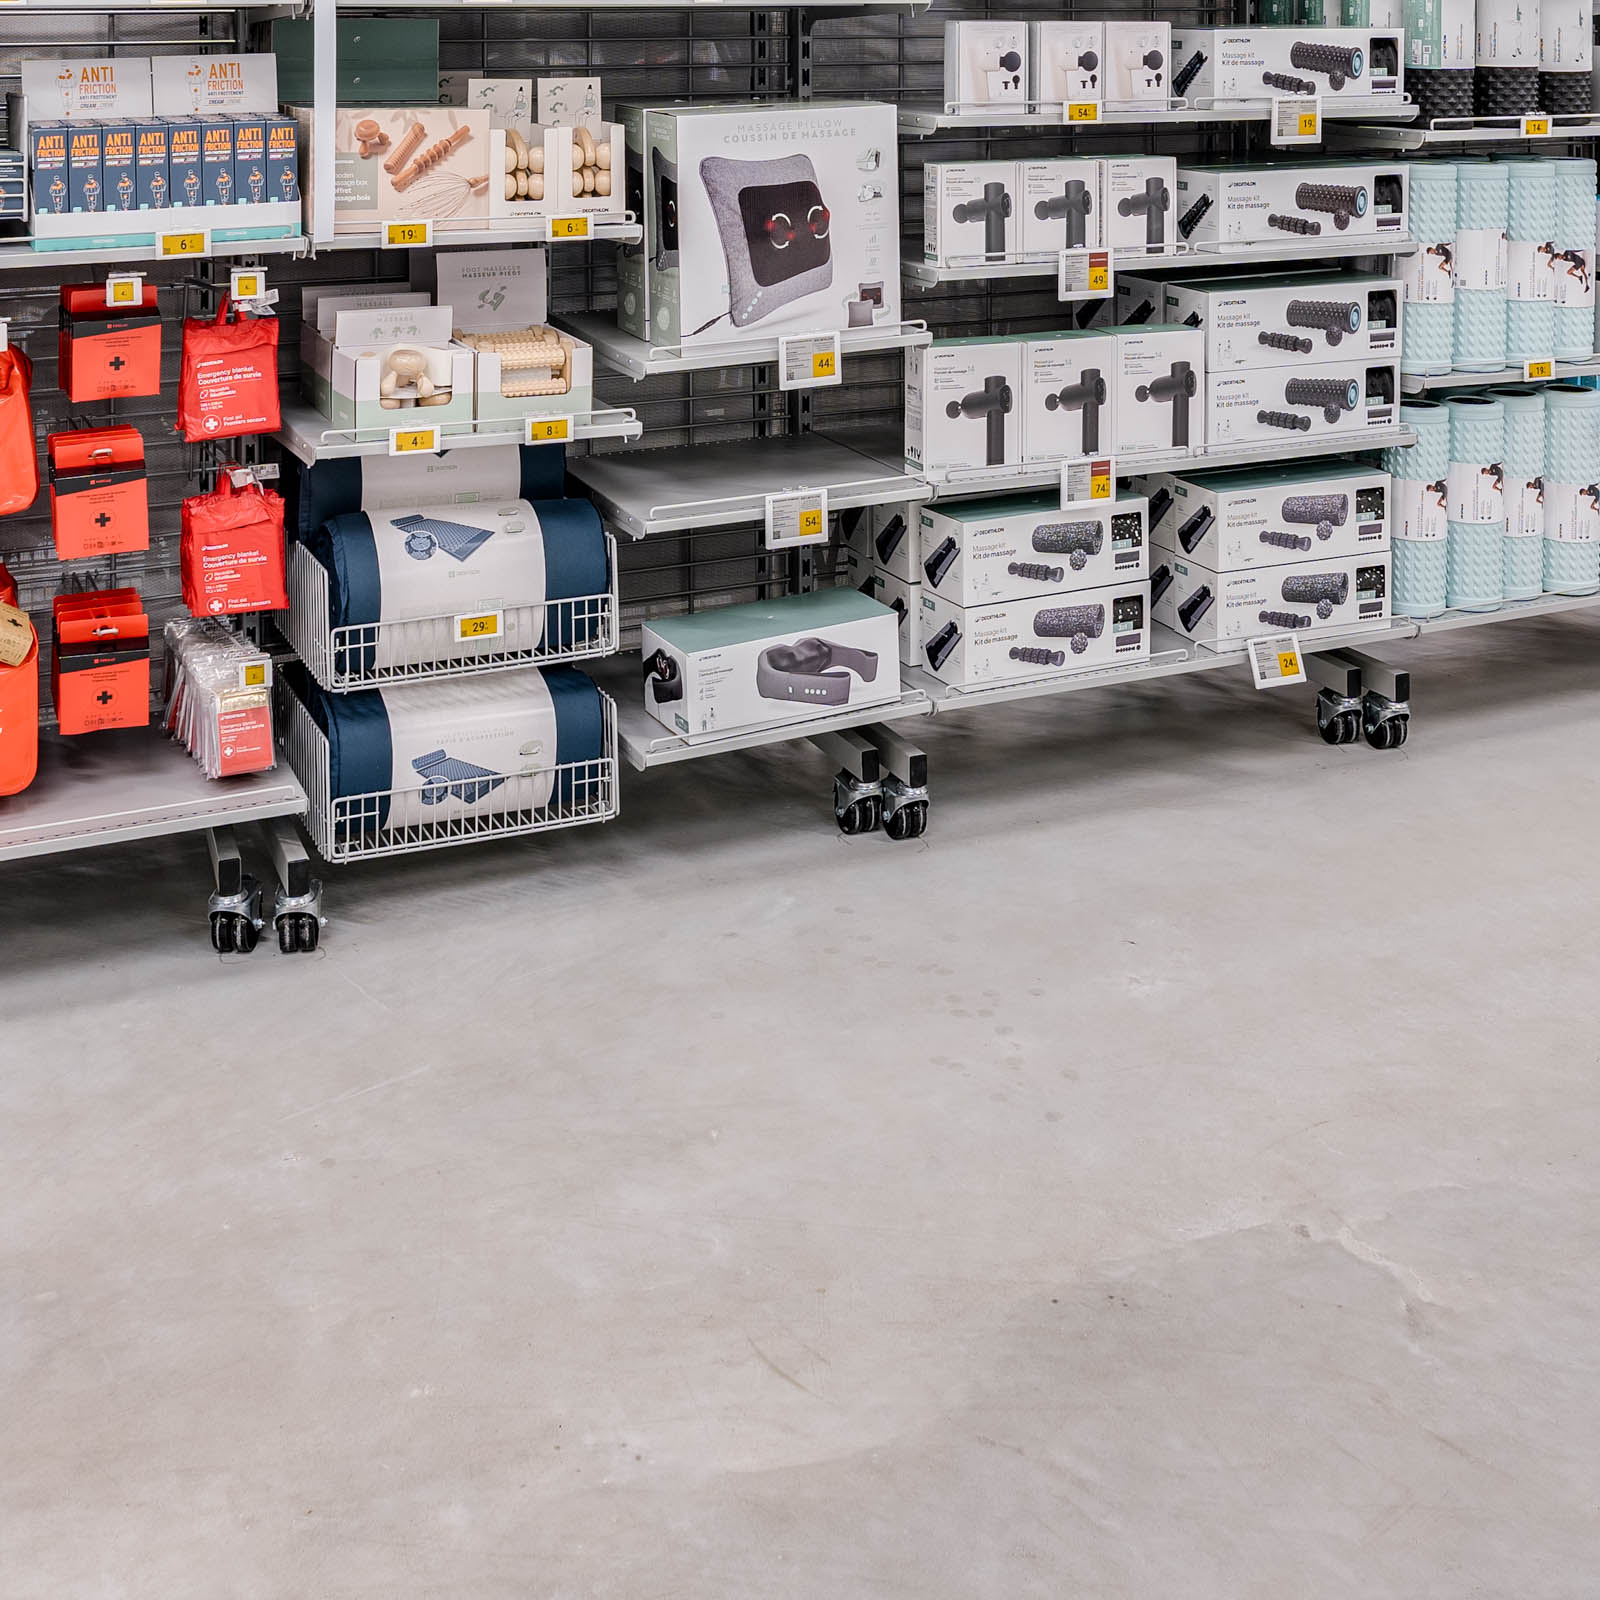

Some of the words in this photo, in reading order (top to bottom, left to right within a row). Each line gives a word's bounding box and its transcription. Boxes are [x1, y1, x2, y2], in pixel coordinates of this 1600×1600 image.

[1222, 52, 1246, 60] Massage
[1239, 59, 1264, 67] massage
[81, 67, 113, 82] ANTI
[209, 63, 240, 78] ANTI
[79, 83, 116, 93] FRICTION
[208, 80, 243, 90] FRICTION
[1078, 108, 1088, 117] 54
[737, 122, 792, 133] MASSAGE
[798, 119, 843, 129] PILLOW
[1303, 120, 1312, 128] 19
[173, 131, 197, 144] ANTI
[238, 128, 261, 141] ANTI
[270, 127, 294, 140] ANTI
[723, 133, 777, 143] COUSSIN
[783, 132, 797, 140] DE
[802, 128, 856, 138] MASSAGE
[39, 136, 63, 148] ANTI
[106, 133, 131, 146] ANTI
[237, 140, 263, 149] FRICTION
[269, 140, 295, 148] FRICTION
[105, 145, 133, 154] FRICTION
[172, 143, 199, 153] FRICTION
[37, 149, 65, 158] FRICTION
[568, 223, 572, 232] 6
[401, 230, 413, 240] 19
[180, 240, 187, 250] 6
[1093, 275, 1103, 285] 49
[818, 358, 830, 367] 44
[547, 427, 553, 435] 8
[412, 437, 418, 447] 4
[1096, 484, 1106, 493] 74
[806, 516, 816, 527] 54
[990, 549, 1016, 558] massage
[472, 621, 485, 634] 29
[1284, 658, 1294, 668] 24
